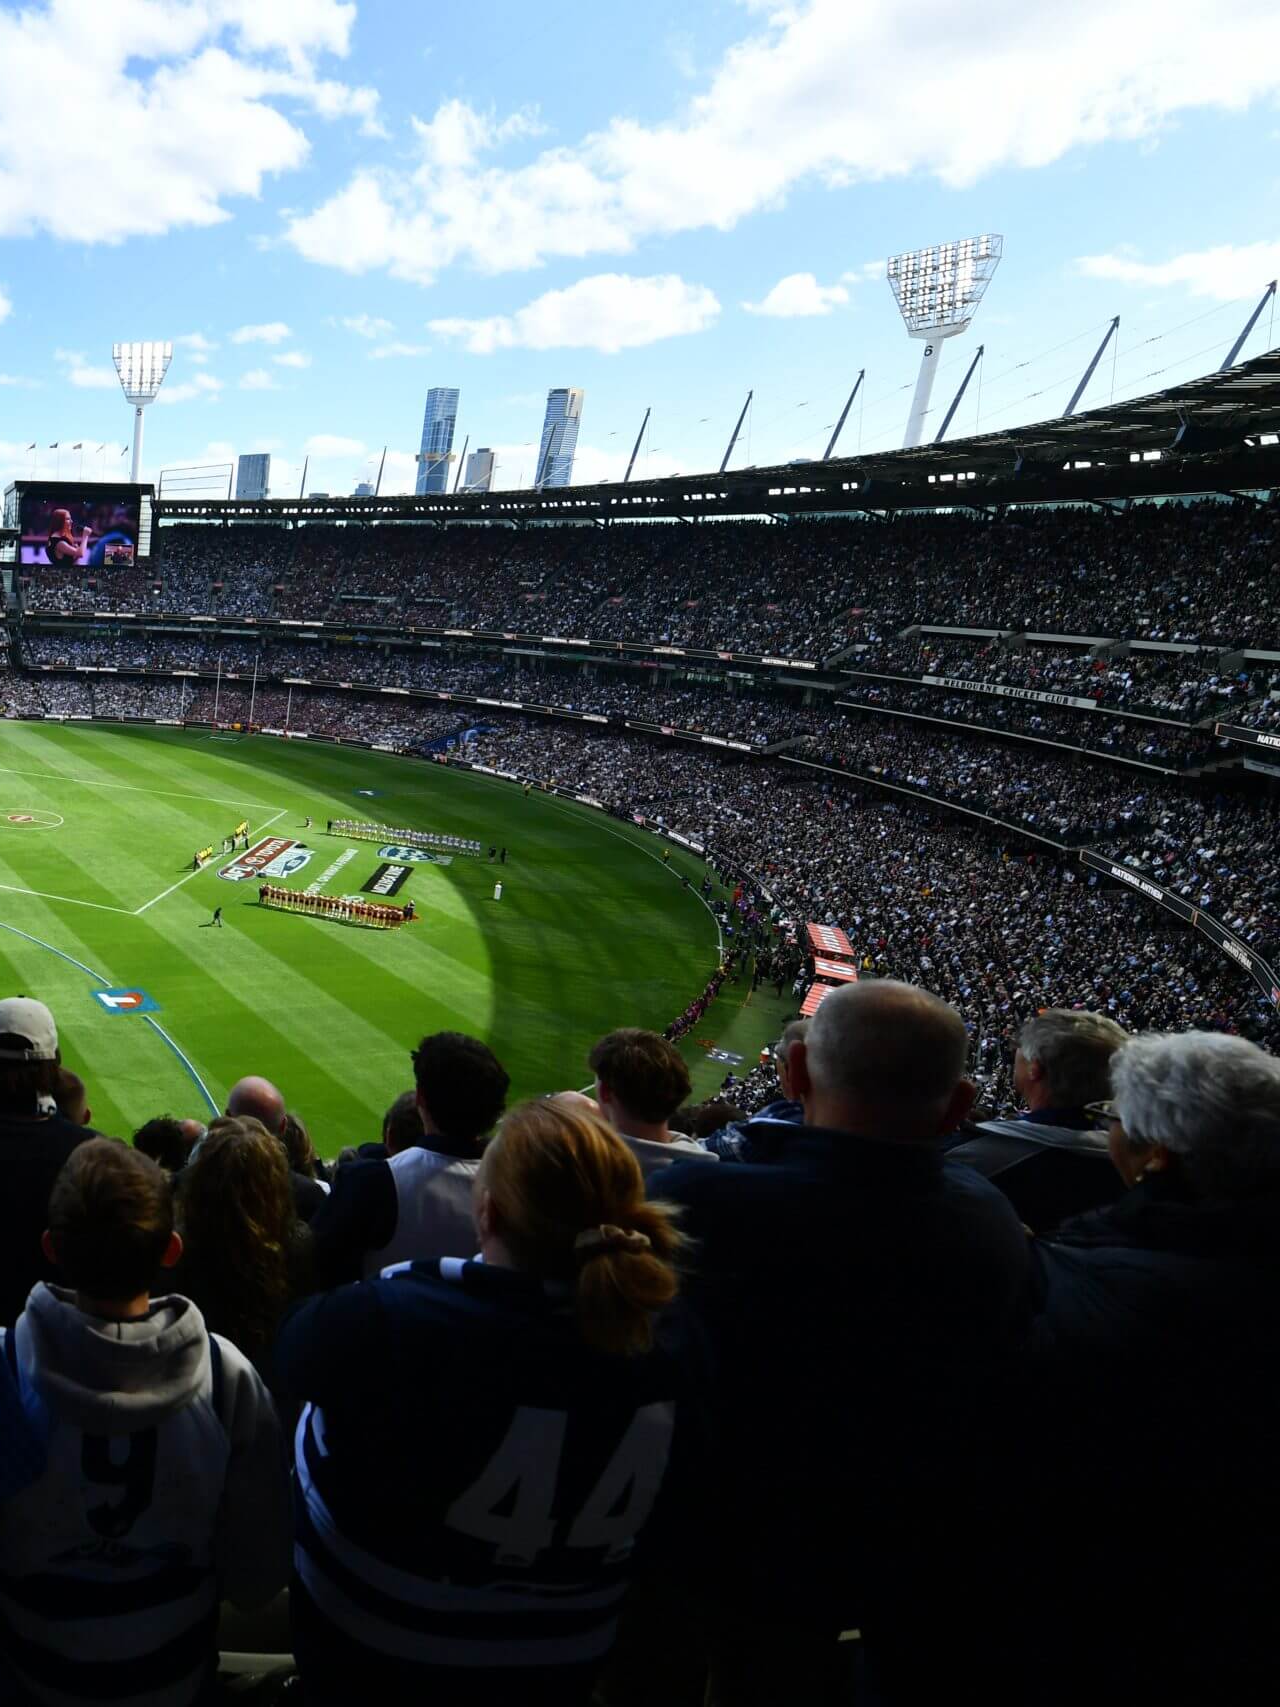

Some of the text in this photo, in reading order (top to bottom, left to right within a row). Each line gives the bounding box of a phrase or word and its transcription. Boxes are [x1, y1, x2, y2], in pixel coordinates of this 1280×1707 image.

[923, 345, 933, 357] 6
[136, 407, 143, 416] 5
[944, 678, 1069, 705] MELBOURNE CRICKET CLUB
[222, 865, 254, 881] AFL
[1111, 866, 1164, 901] NATIONAL ANTHEM
[81, 1426, 156, 1538] 9
[444, 1400, 677, 1567] 44
